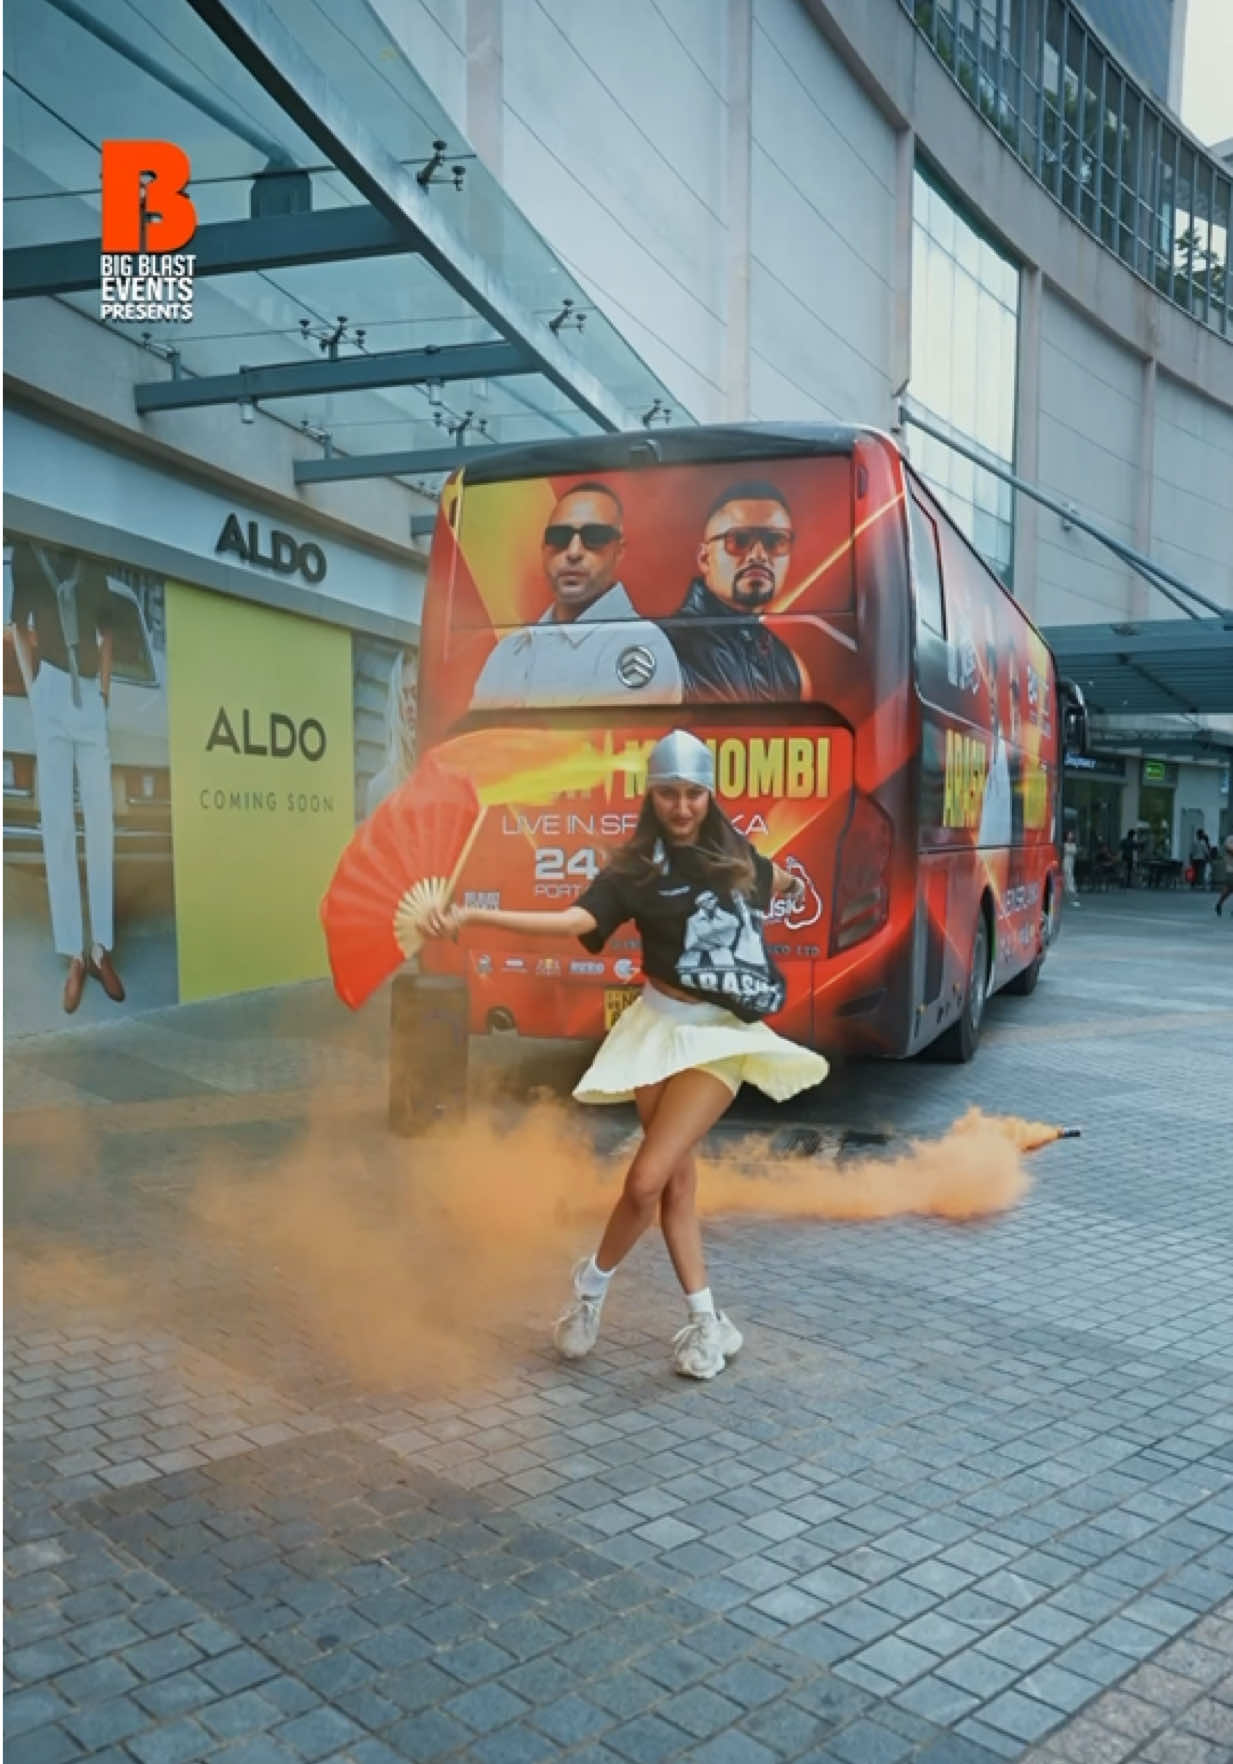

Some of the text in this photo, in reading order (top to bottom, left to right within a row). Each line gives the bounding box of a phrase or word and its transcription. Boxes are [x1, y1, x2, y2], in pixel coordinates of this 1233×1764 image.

[214, 512, 327, 584] ALDO
[206, 706, 327, 762] ALDO
[199, 788, 335, 813] COMING SOON
[502, 814, 563, 835] LIVE
[567, 814, 594, 835] IN
[534, 883, 582, 899] PORT
